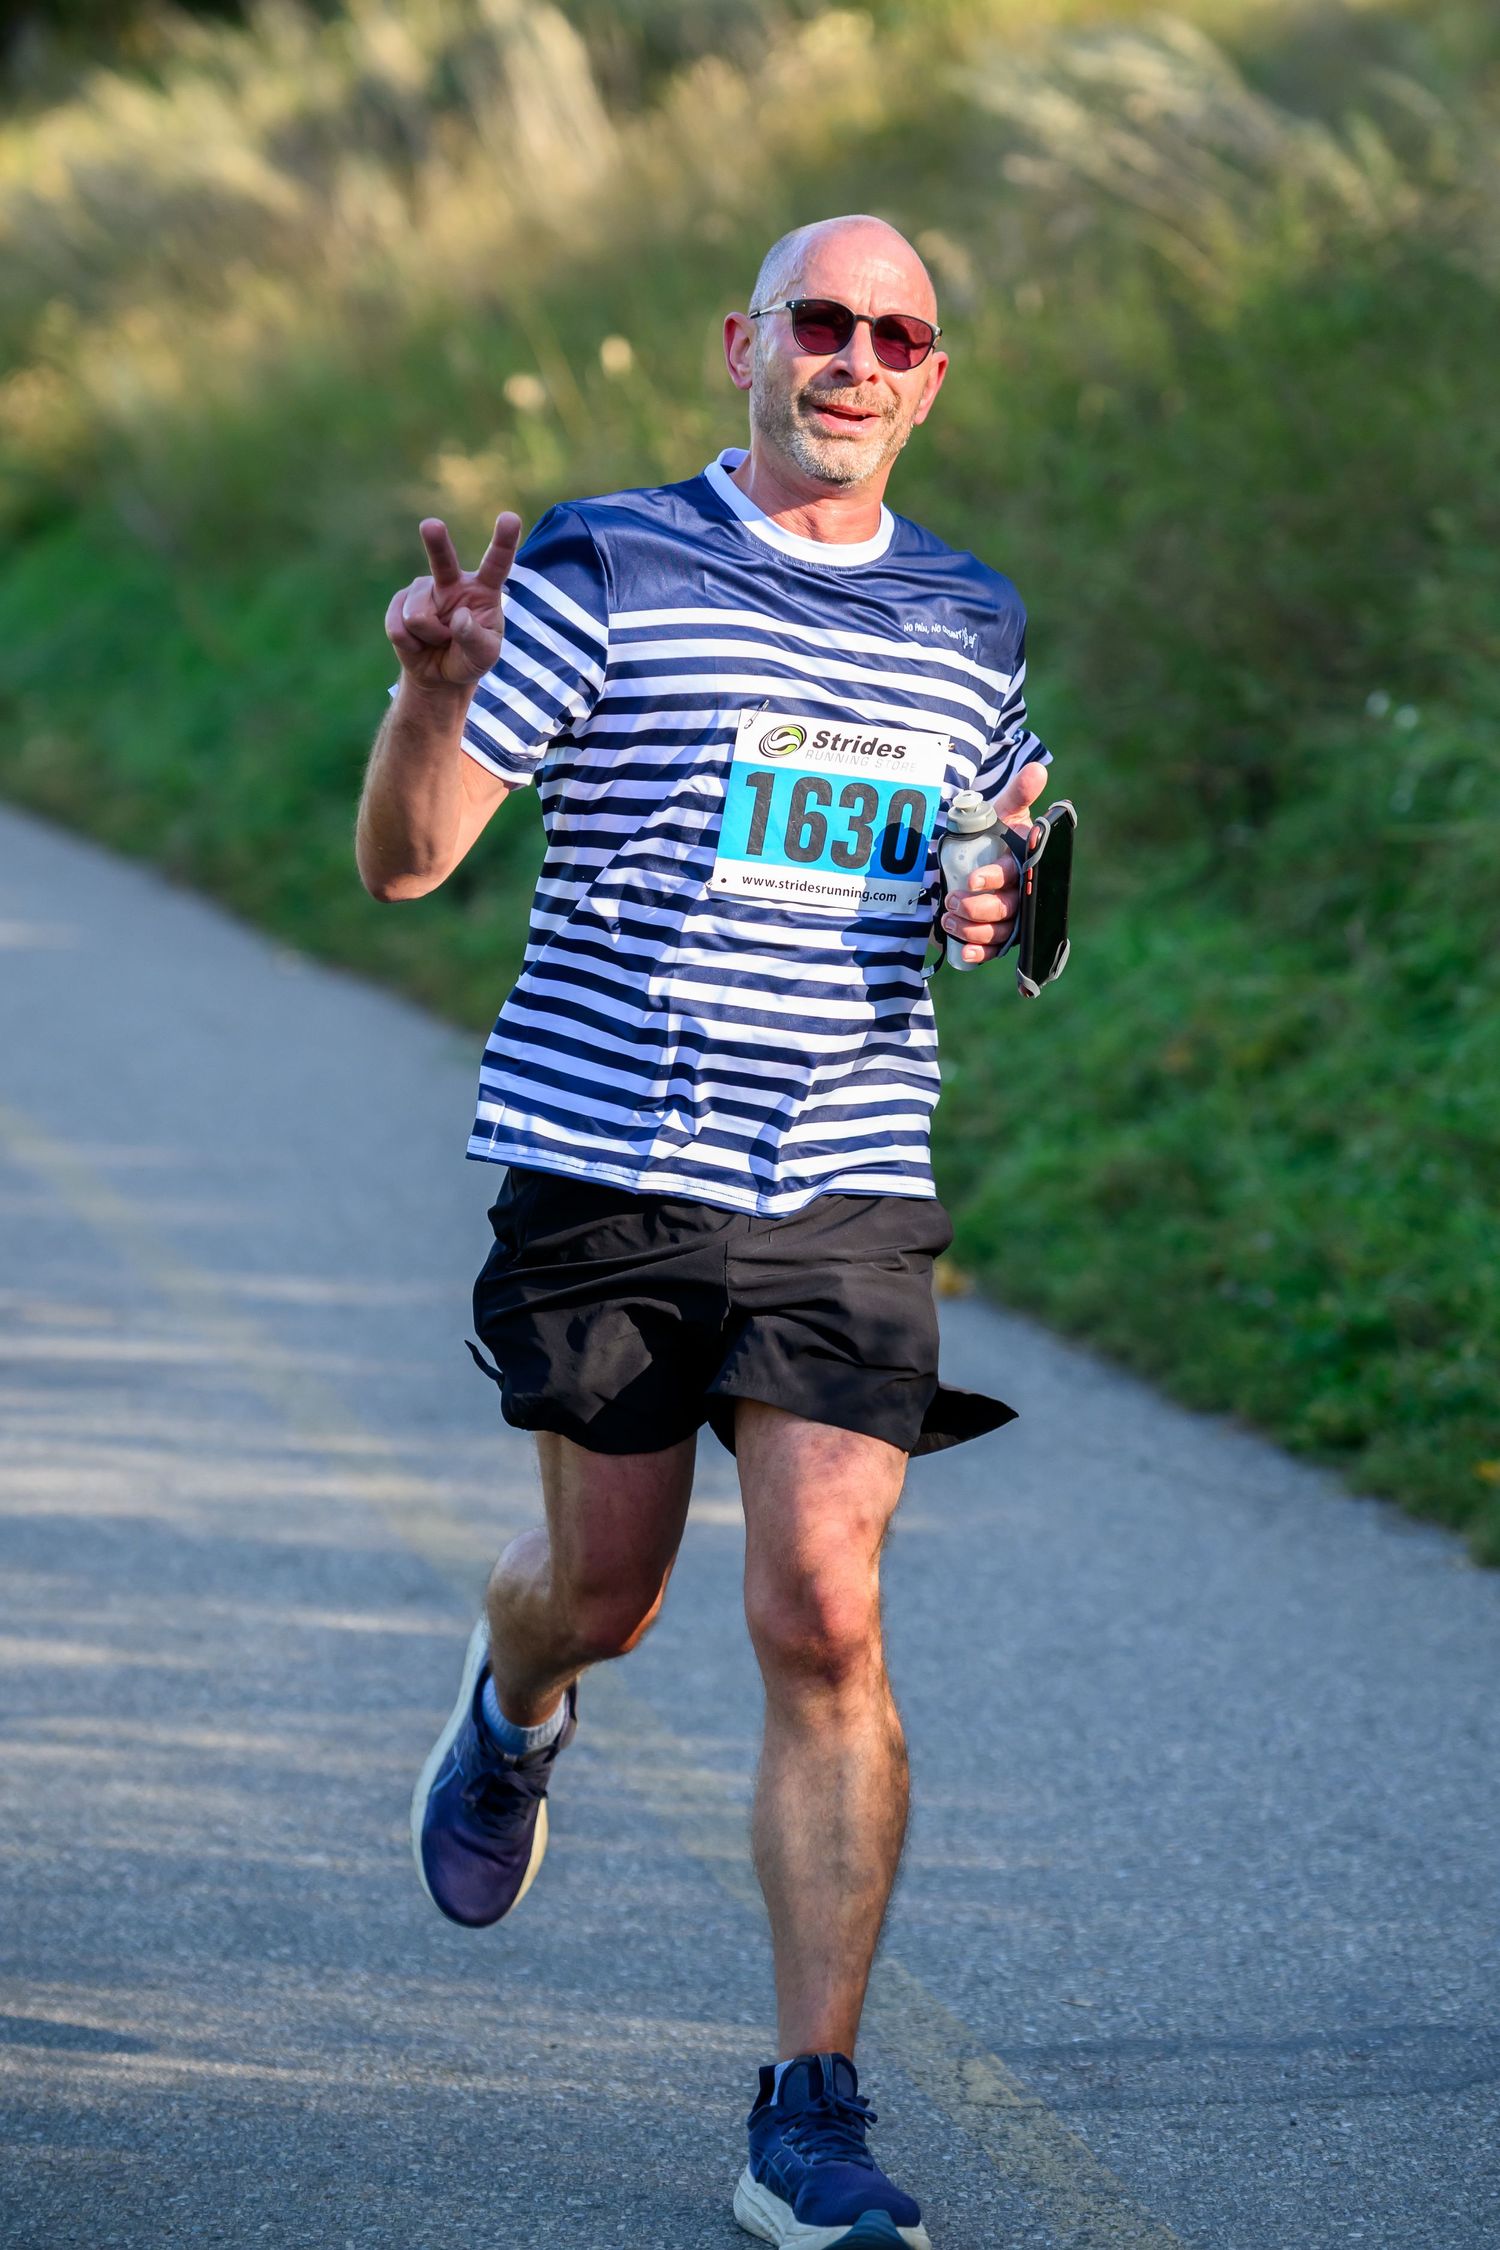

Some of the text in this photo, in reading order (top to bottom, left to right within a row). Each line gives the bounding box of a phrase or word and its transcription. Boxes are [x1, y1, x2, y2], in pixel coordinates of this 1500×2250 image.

[904, 622, 914, 632] NO
[932, 623, 941, 633] NO
[812, 730, 907, 760] Strides
[805, 749, 919, 773] RUNNING STORE
[745, 771, 927, 875] 1630
[742, 874, 898, 903] www.stridesrunning.com
